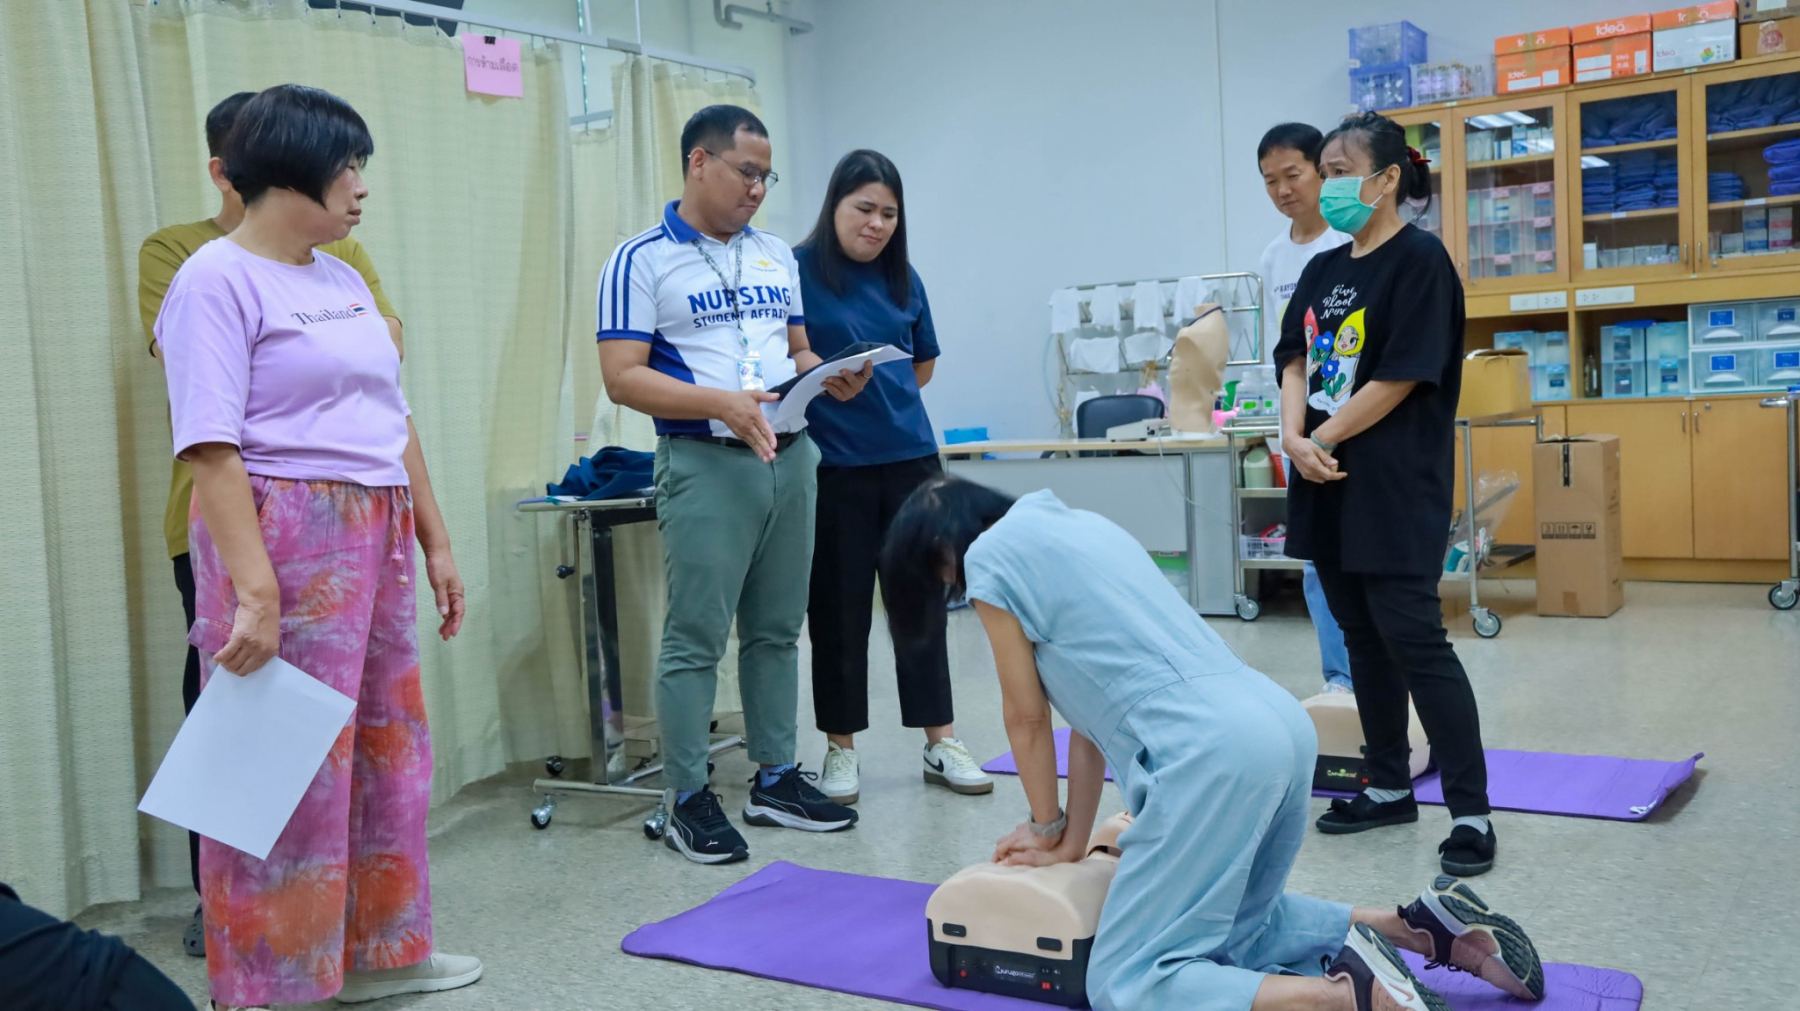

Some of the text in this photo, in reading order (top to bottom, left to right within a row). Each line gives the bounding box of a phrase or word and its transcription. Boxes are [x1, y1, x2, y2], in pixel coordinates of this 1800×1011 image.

[1280, 282, 1298, 292] RAYON
[687, 285, 791, 314] NURSING
[1322, 292, 1358, 308] Blood
[290, 306, 357, 325] Thailand
[693, 310, 745, 329] STUDENT
[1320, 307, 1348, 320] Now
